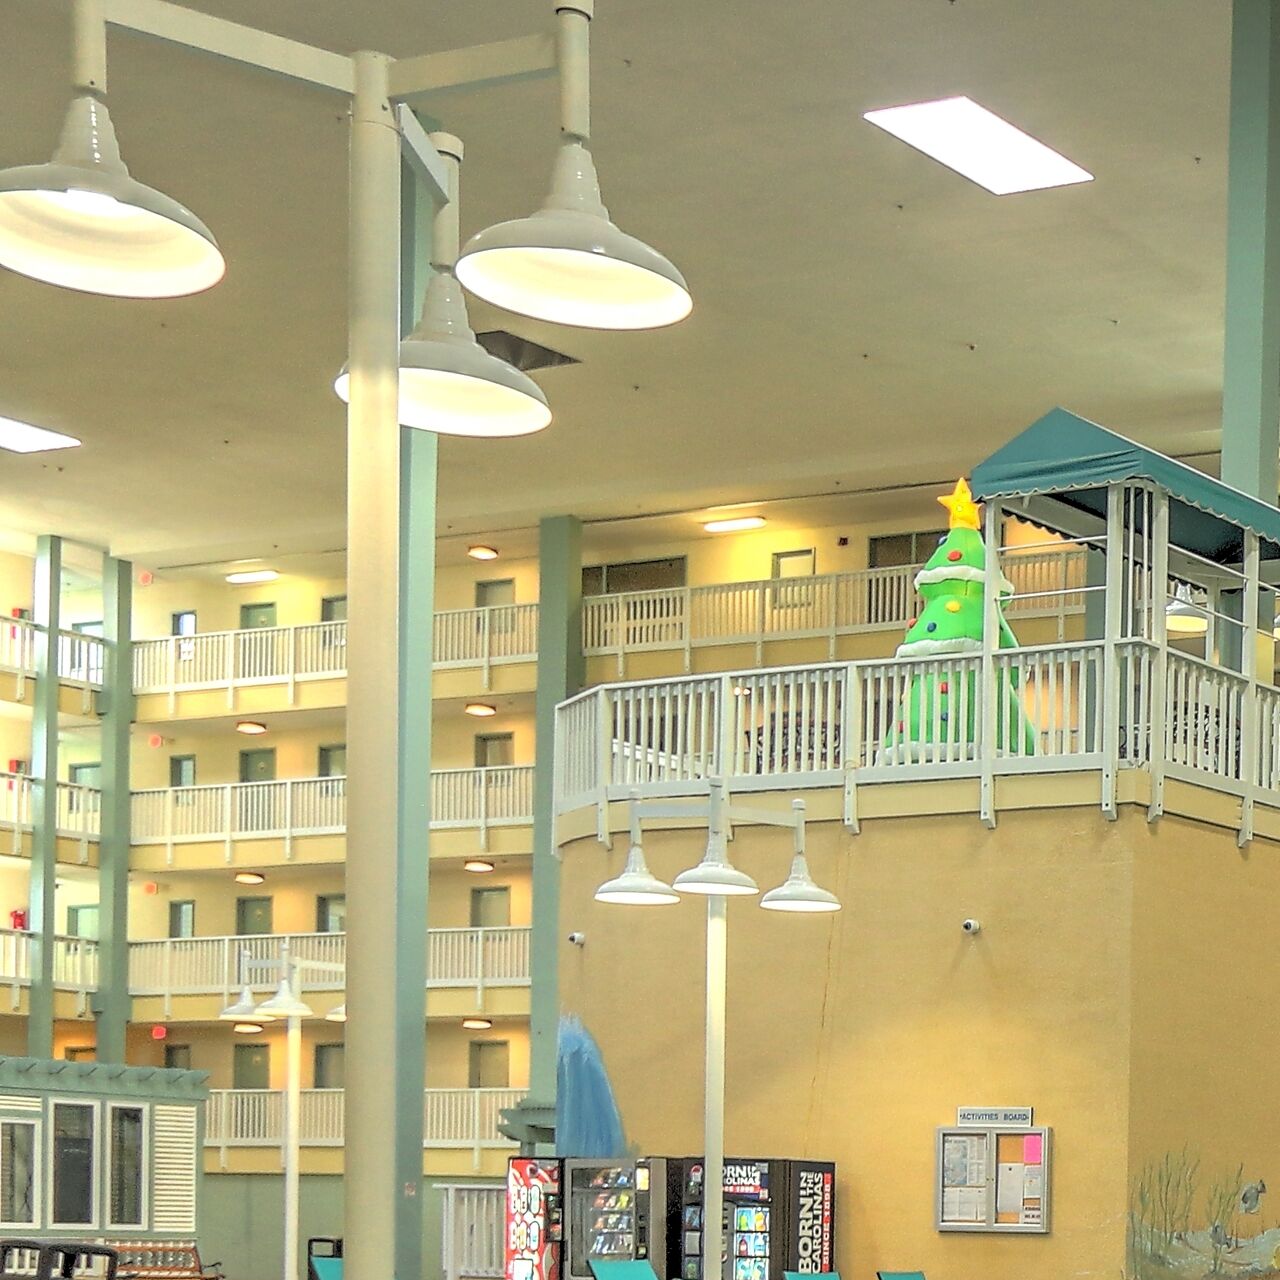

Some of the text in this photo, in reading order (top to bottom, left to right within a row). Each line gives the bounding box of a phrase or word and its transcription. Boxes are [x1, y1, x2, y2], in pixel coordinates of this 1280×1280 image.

[961, 1112, 1028, 1121] ACTIVITIES BOARD
[806, 1171, 815, 1196] THE
[798, 1171, 814, 1274] BORN IN
[812, 1171, 823, 1274] CAROLINAS
[822, 1222, 831, 1266] SINCE
